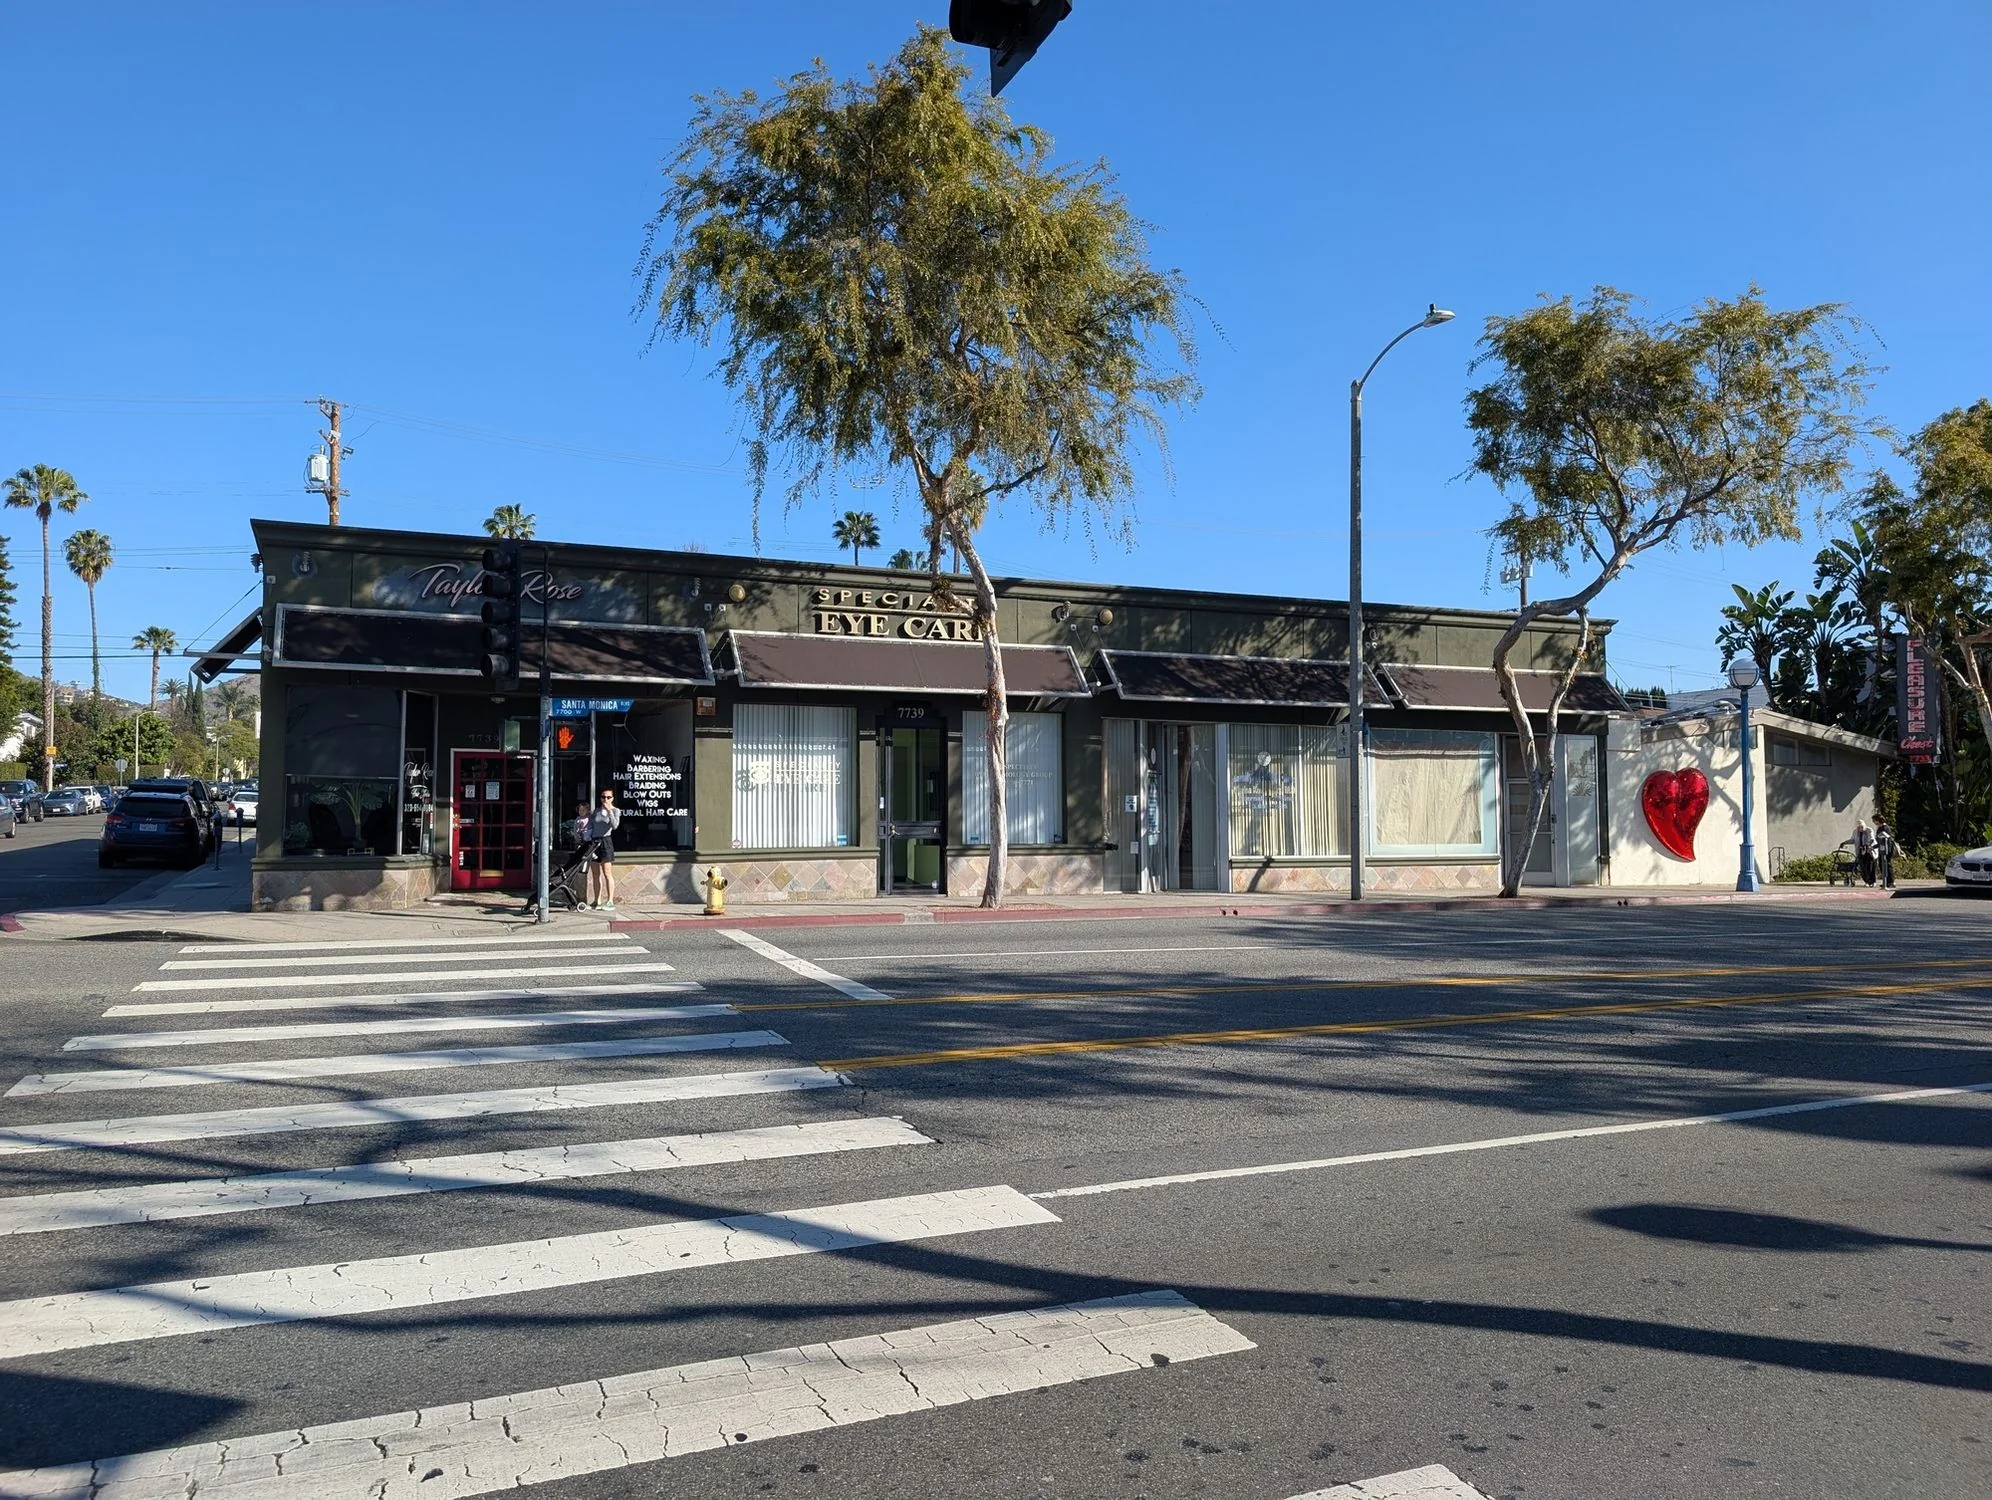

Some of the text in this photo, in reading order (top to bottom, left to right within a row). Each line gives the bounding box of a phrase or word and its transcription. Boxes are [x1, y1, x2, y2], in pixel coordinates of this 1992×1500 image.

[408, 563, 583, 608] Tayl Rose
[818, 611, 890, 636] EYE
[561, 700, 586, 709] SANTA
[588, 700, 618, 710] MONICA
[897, 707, 925, 719] 7739
[633, 754, 667, 764] WAXING
[626, 763, 672, 773] BARBERING
[613, 772, 682, 781] HAIR EXTENSIONS
[628, 781, 667, 790] BRAIDING
[623, 790, 672, 799] BLOW OUTS
[637, 799, 659, 808] WIGS
[618, 807, 688, 817] TURAL HAIR CARE
